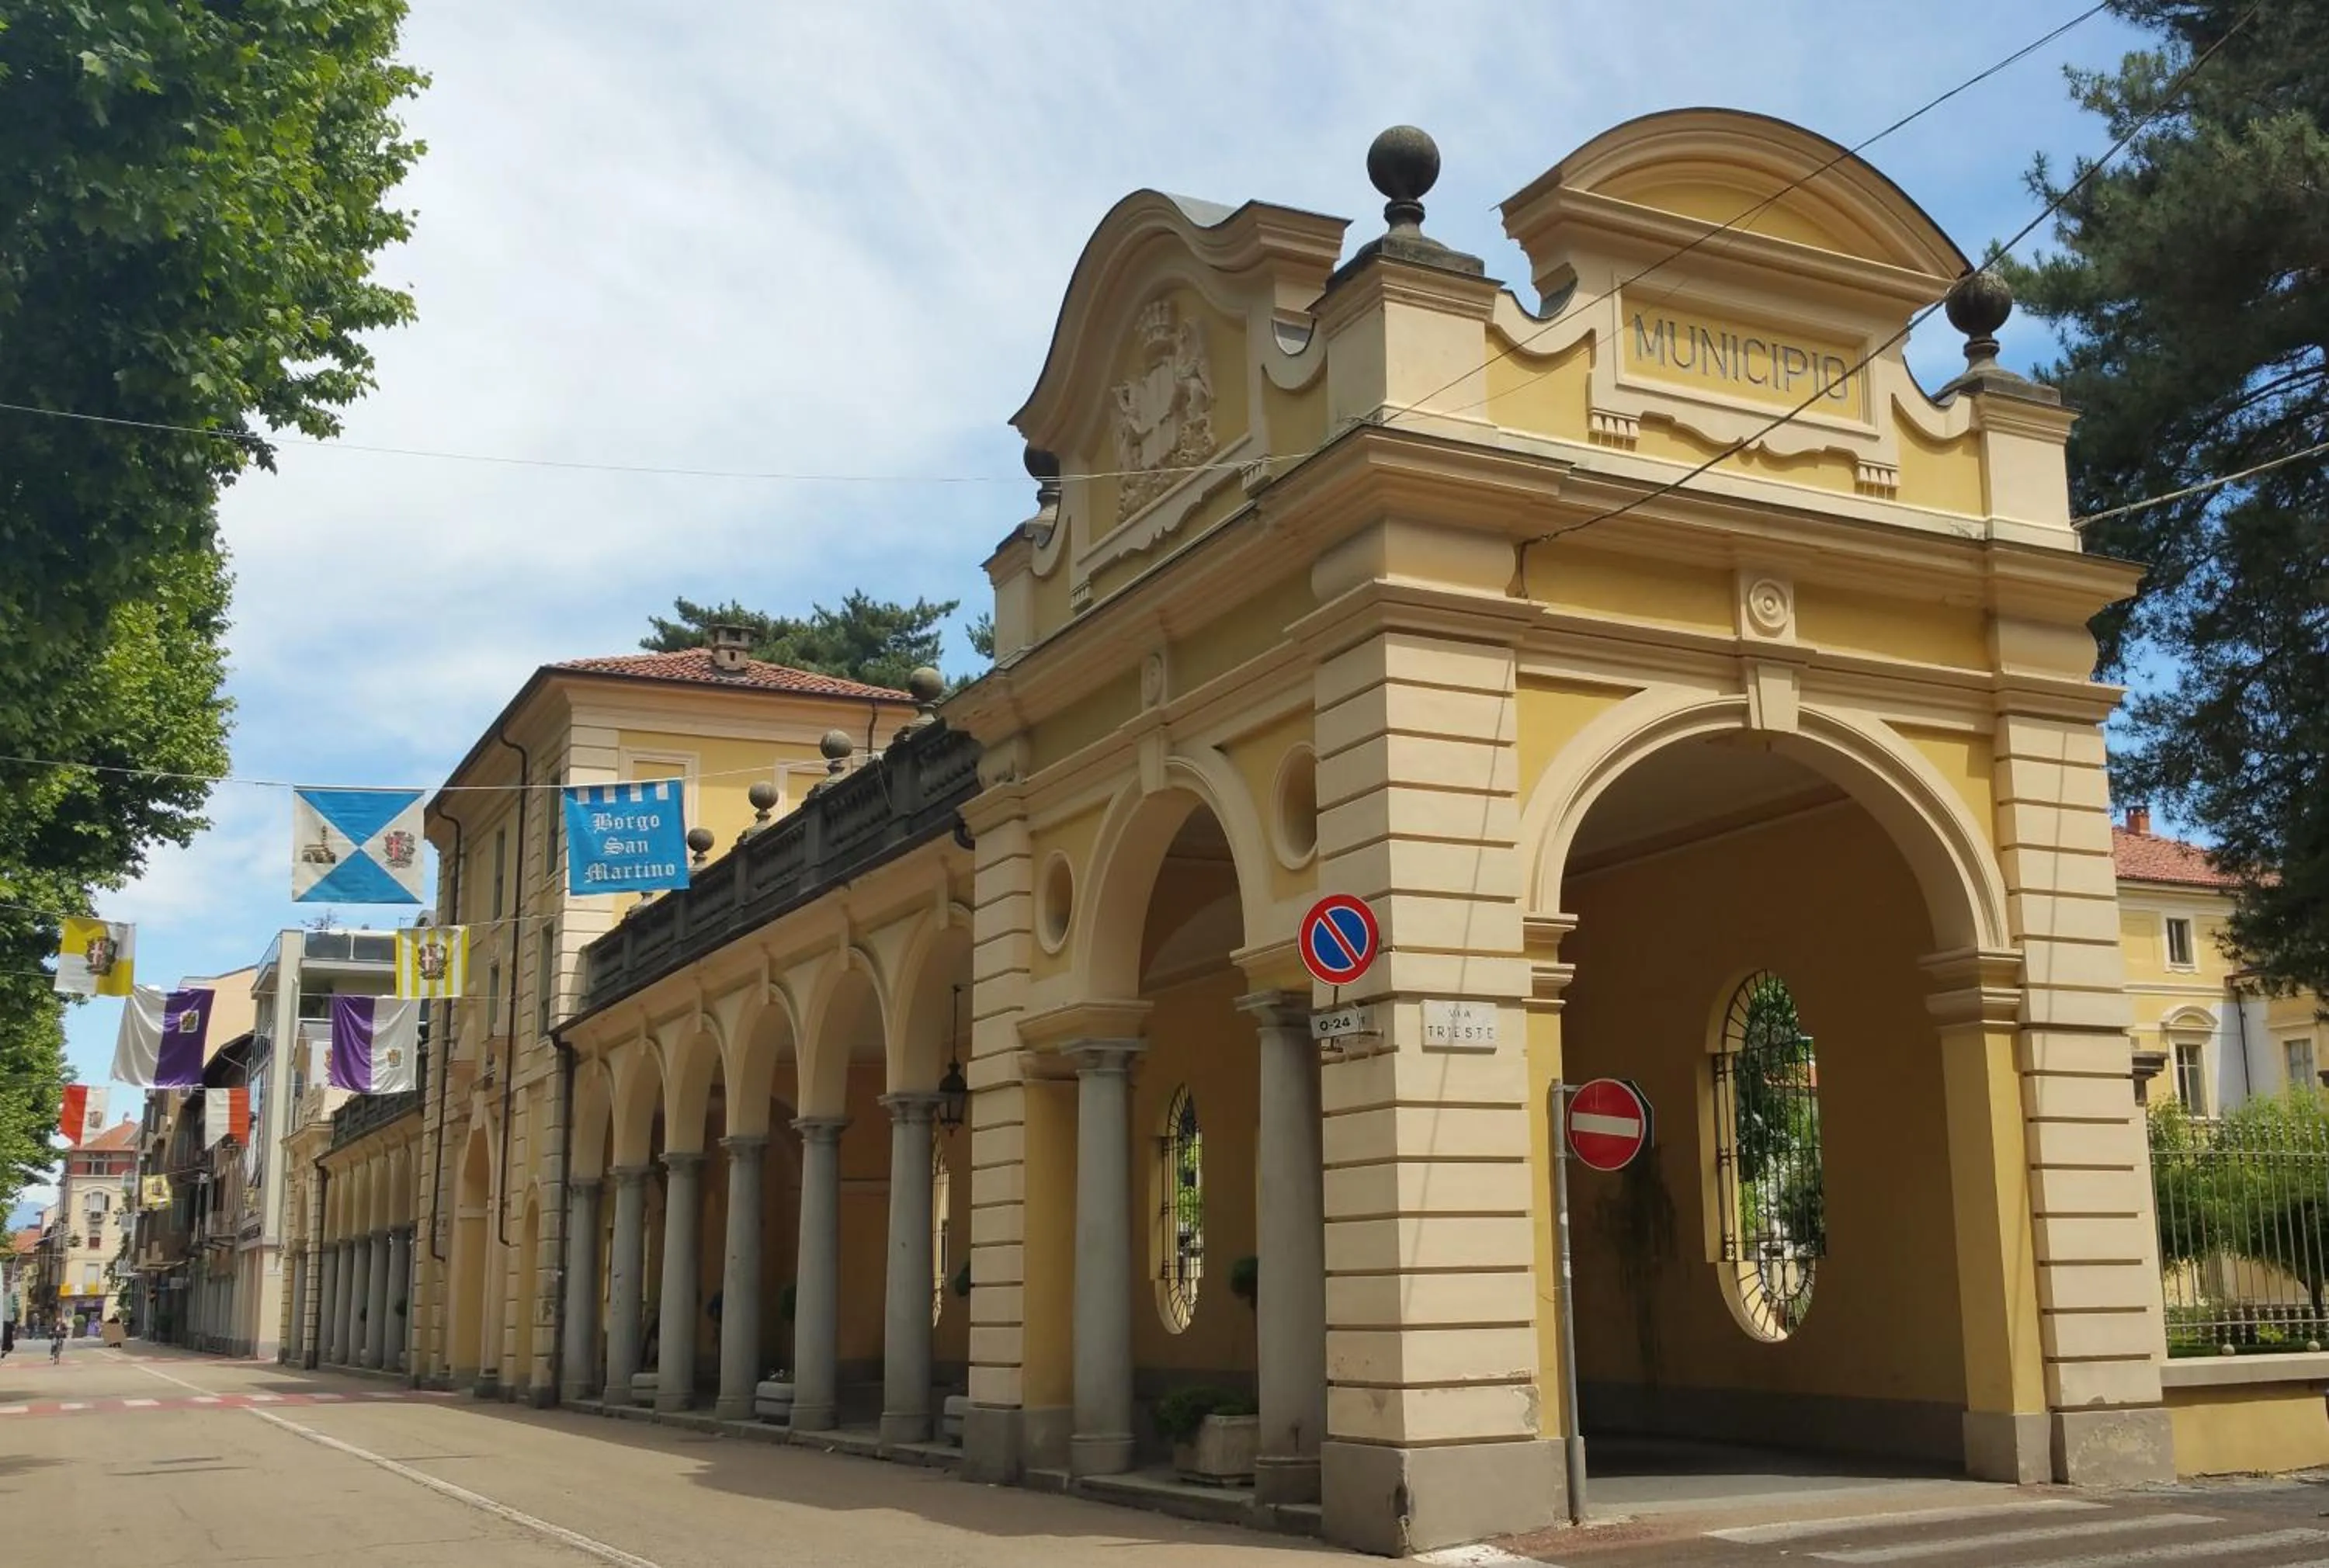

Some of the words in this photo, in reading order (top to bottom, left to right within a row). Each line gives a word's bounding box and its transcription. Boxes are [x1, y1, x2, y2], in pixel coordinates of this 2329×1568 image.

[1634, 313, 1849, 400] MUNICIPIO
[592, 813, 660, 834] Borgo
[603, 837, 648, 855] San
[584, 862, 676, 883] Martino
[1449, 1008, 1471, 1018] VIA
[1320, 1016, 1351, 1032] 0-24
[1428, 1025, 1494, 1039] TRIESTE
